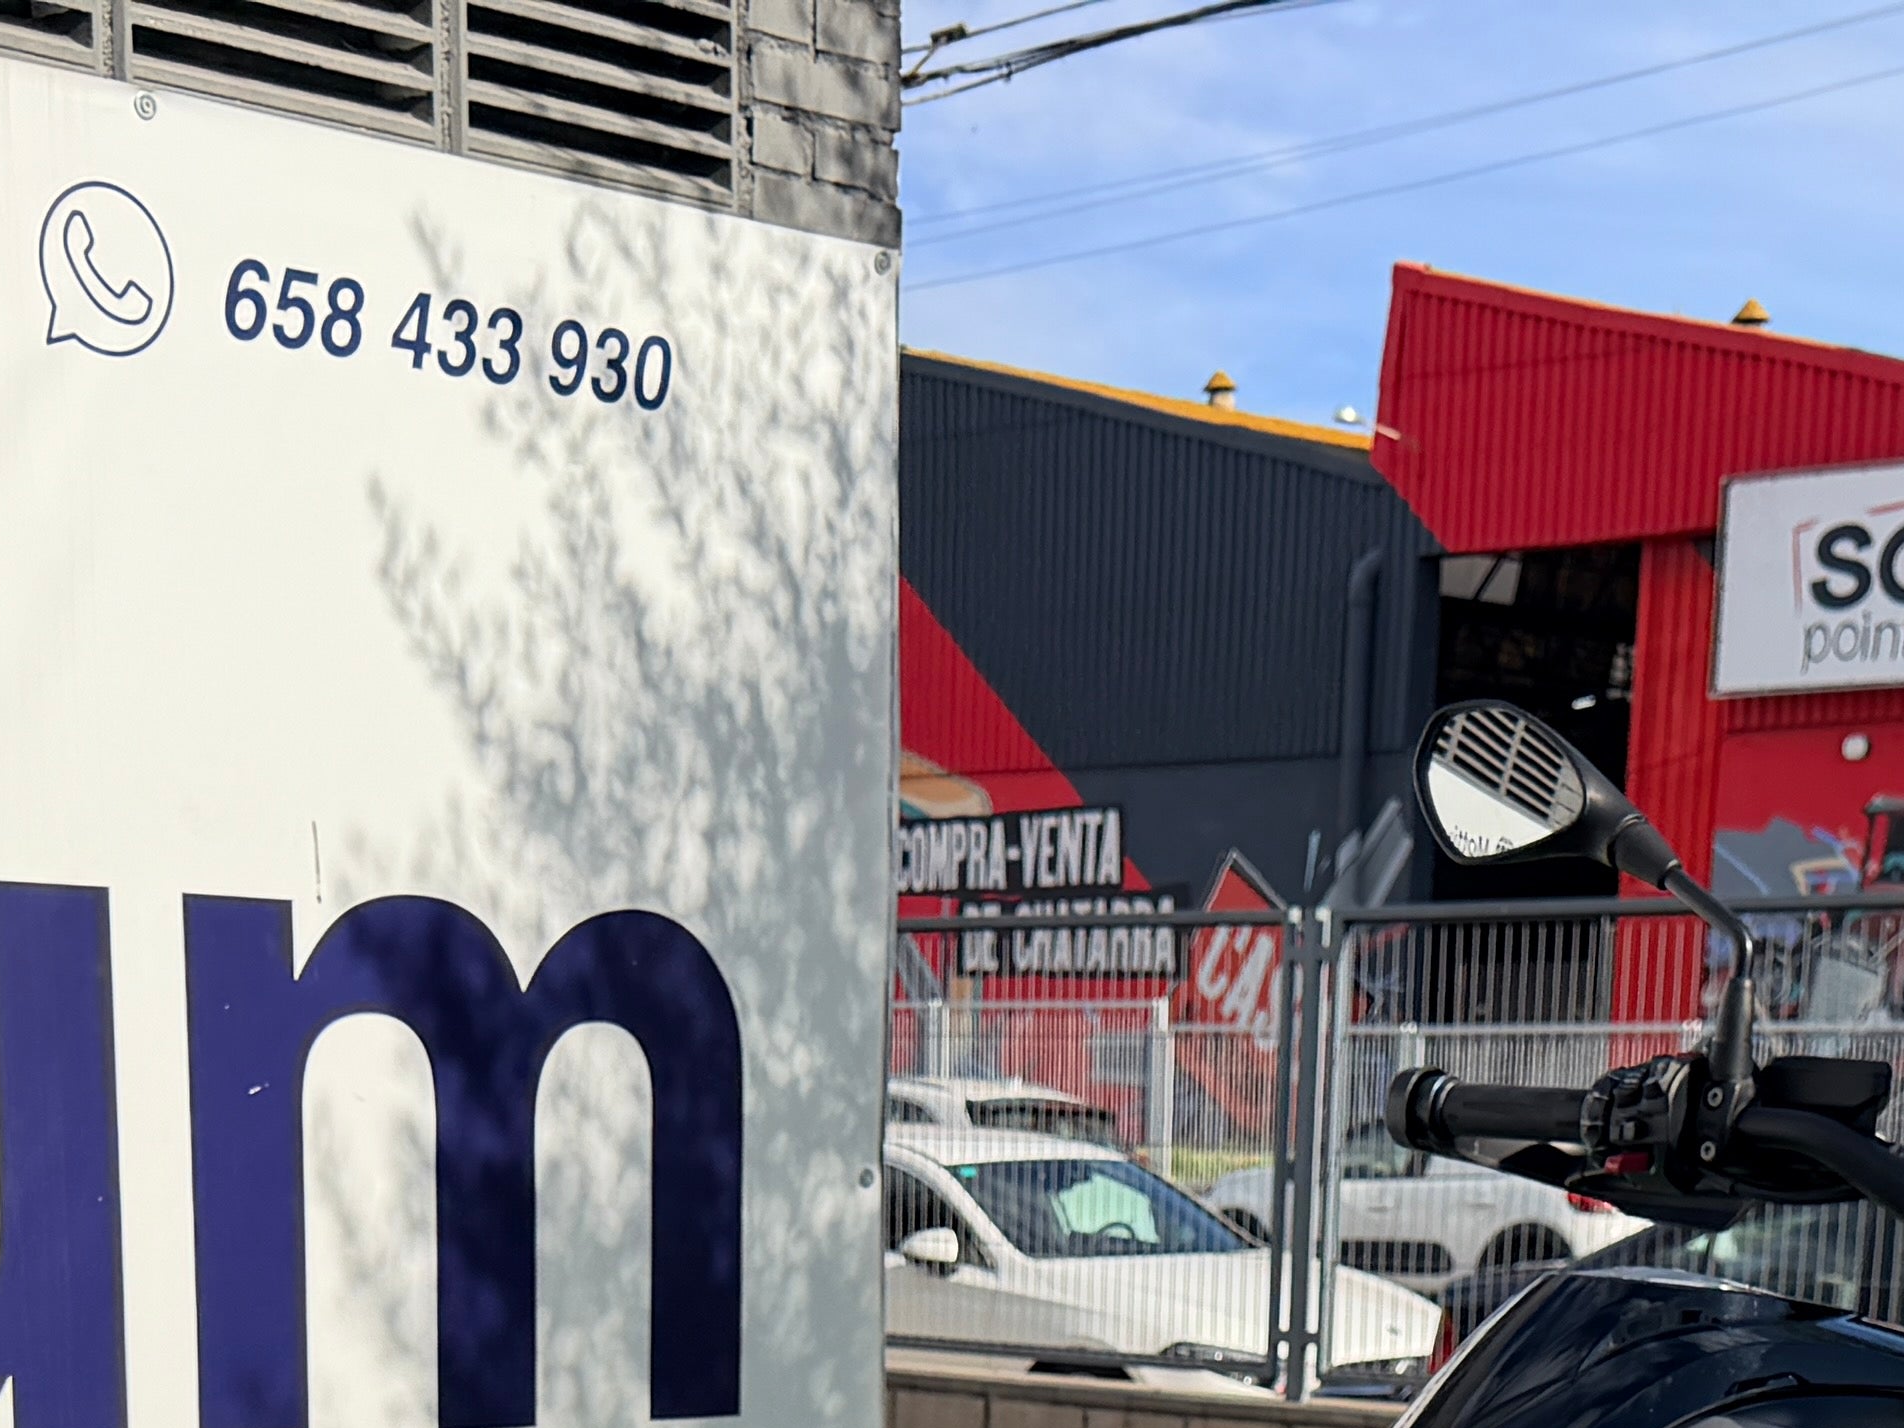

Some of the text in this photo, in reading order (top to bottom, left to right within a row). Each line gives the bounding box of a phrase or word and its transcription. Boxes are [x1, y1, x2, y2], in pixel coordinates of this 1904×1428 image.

[225, 258, 674, 412] 658 433 930
[897, 808, 1123, 892] COMPRA-VENTA
[962, 894, 1176, 974] DE CHATARRA
